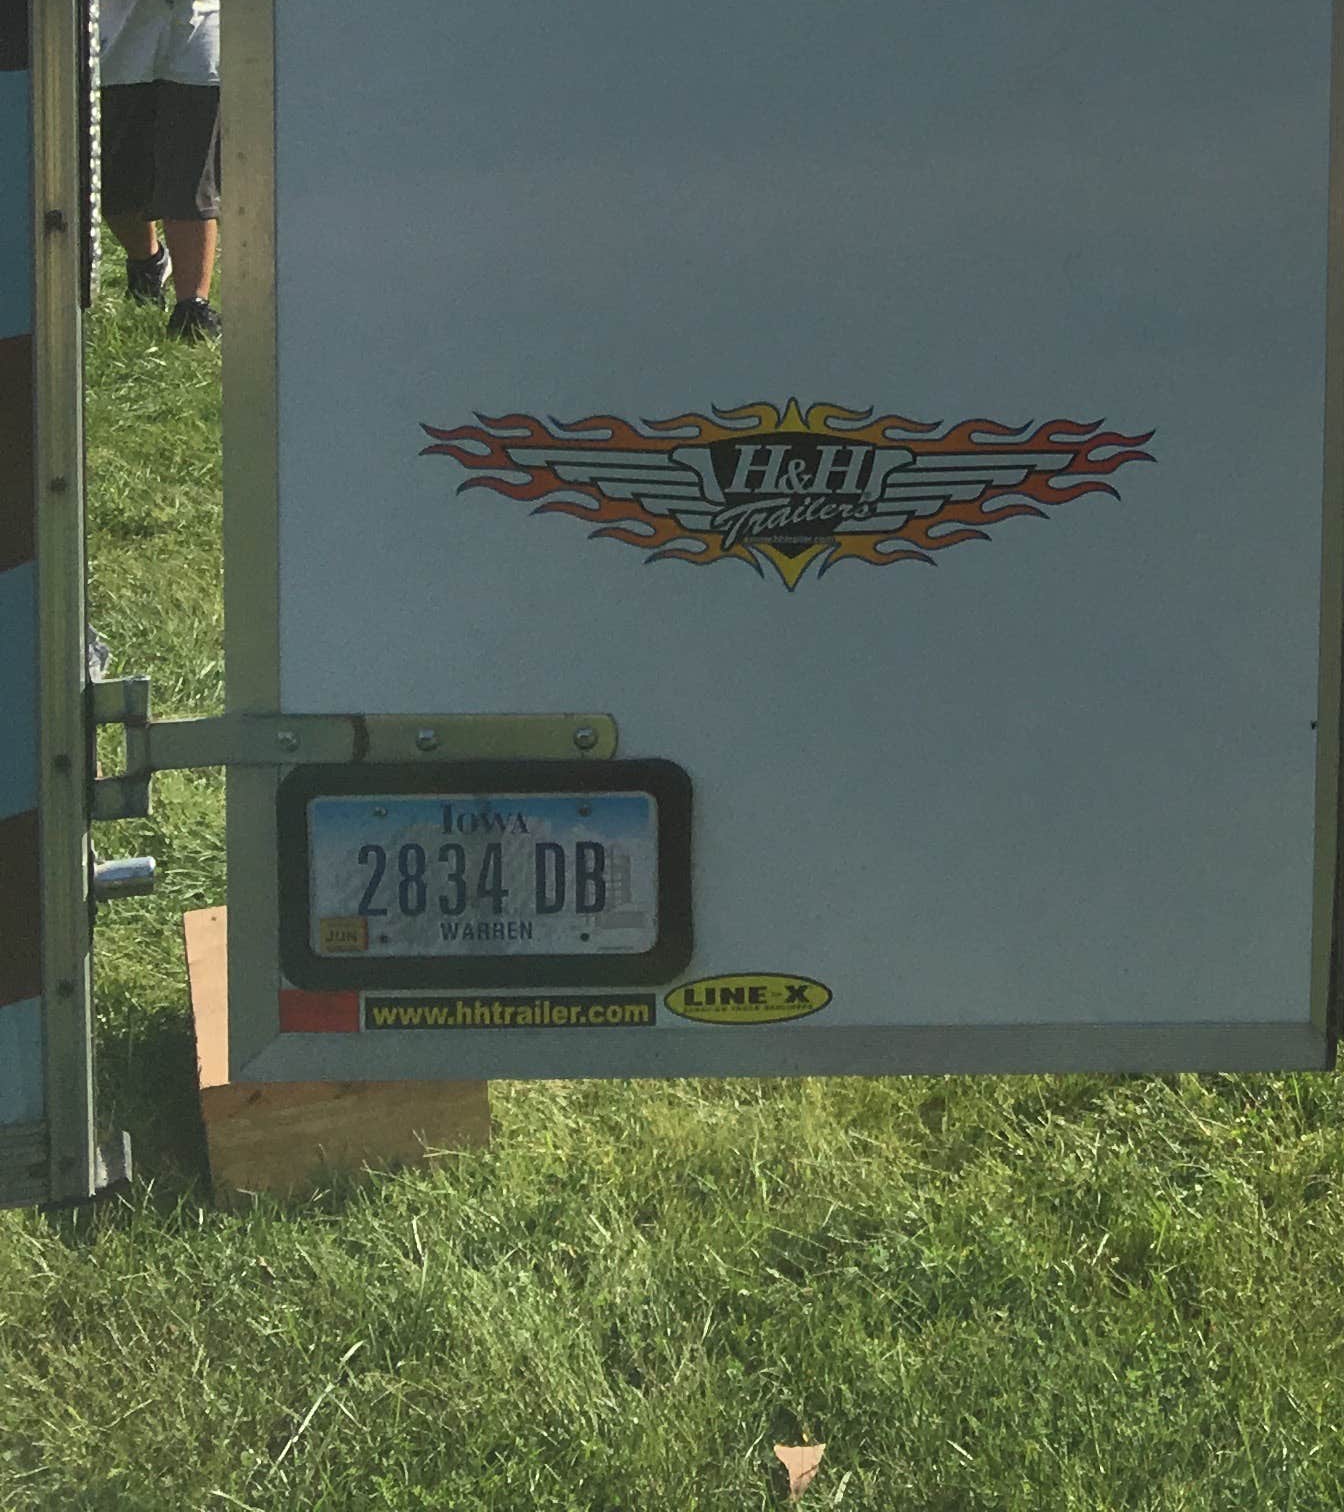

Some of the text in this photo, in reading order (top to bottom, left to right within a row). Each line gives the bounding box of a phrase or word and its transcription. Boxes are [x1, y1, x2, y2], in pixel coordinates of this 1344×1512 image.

[724, 444, 873, 494] H&H
[712, 496, 872, 549] Trailers
[358, 841, 607, 918] 2834 DB
[441, 920, 534, 942] WARREN
[372, 1000, 650, 1026] www.hhtrailer.com
[684, 985, 810, 1006] LINE-X
